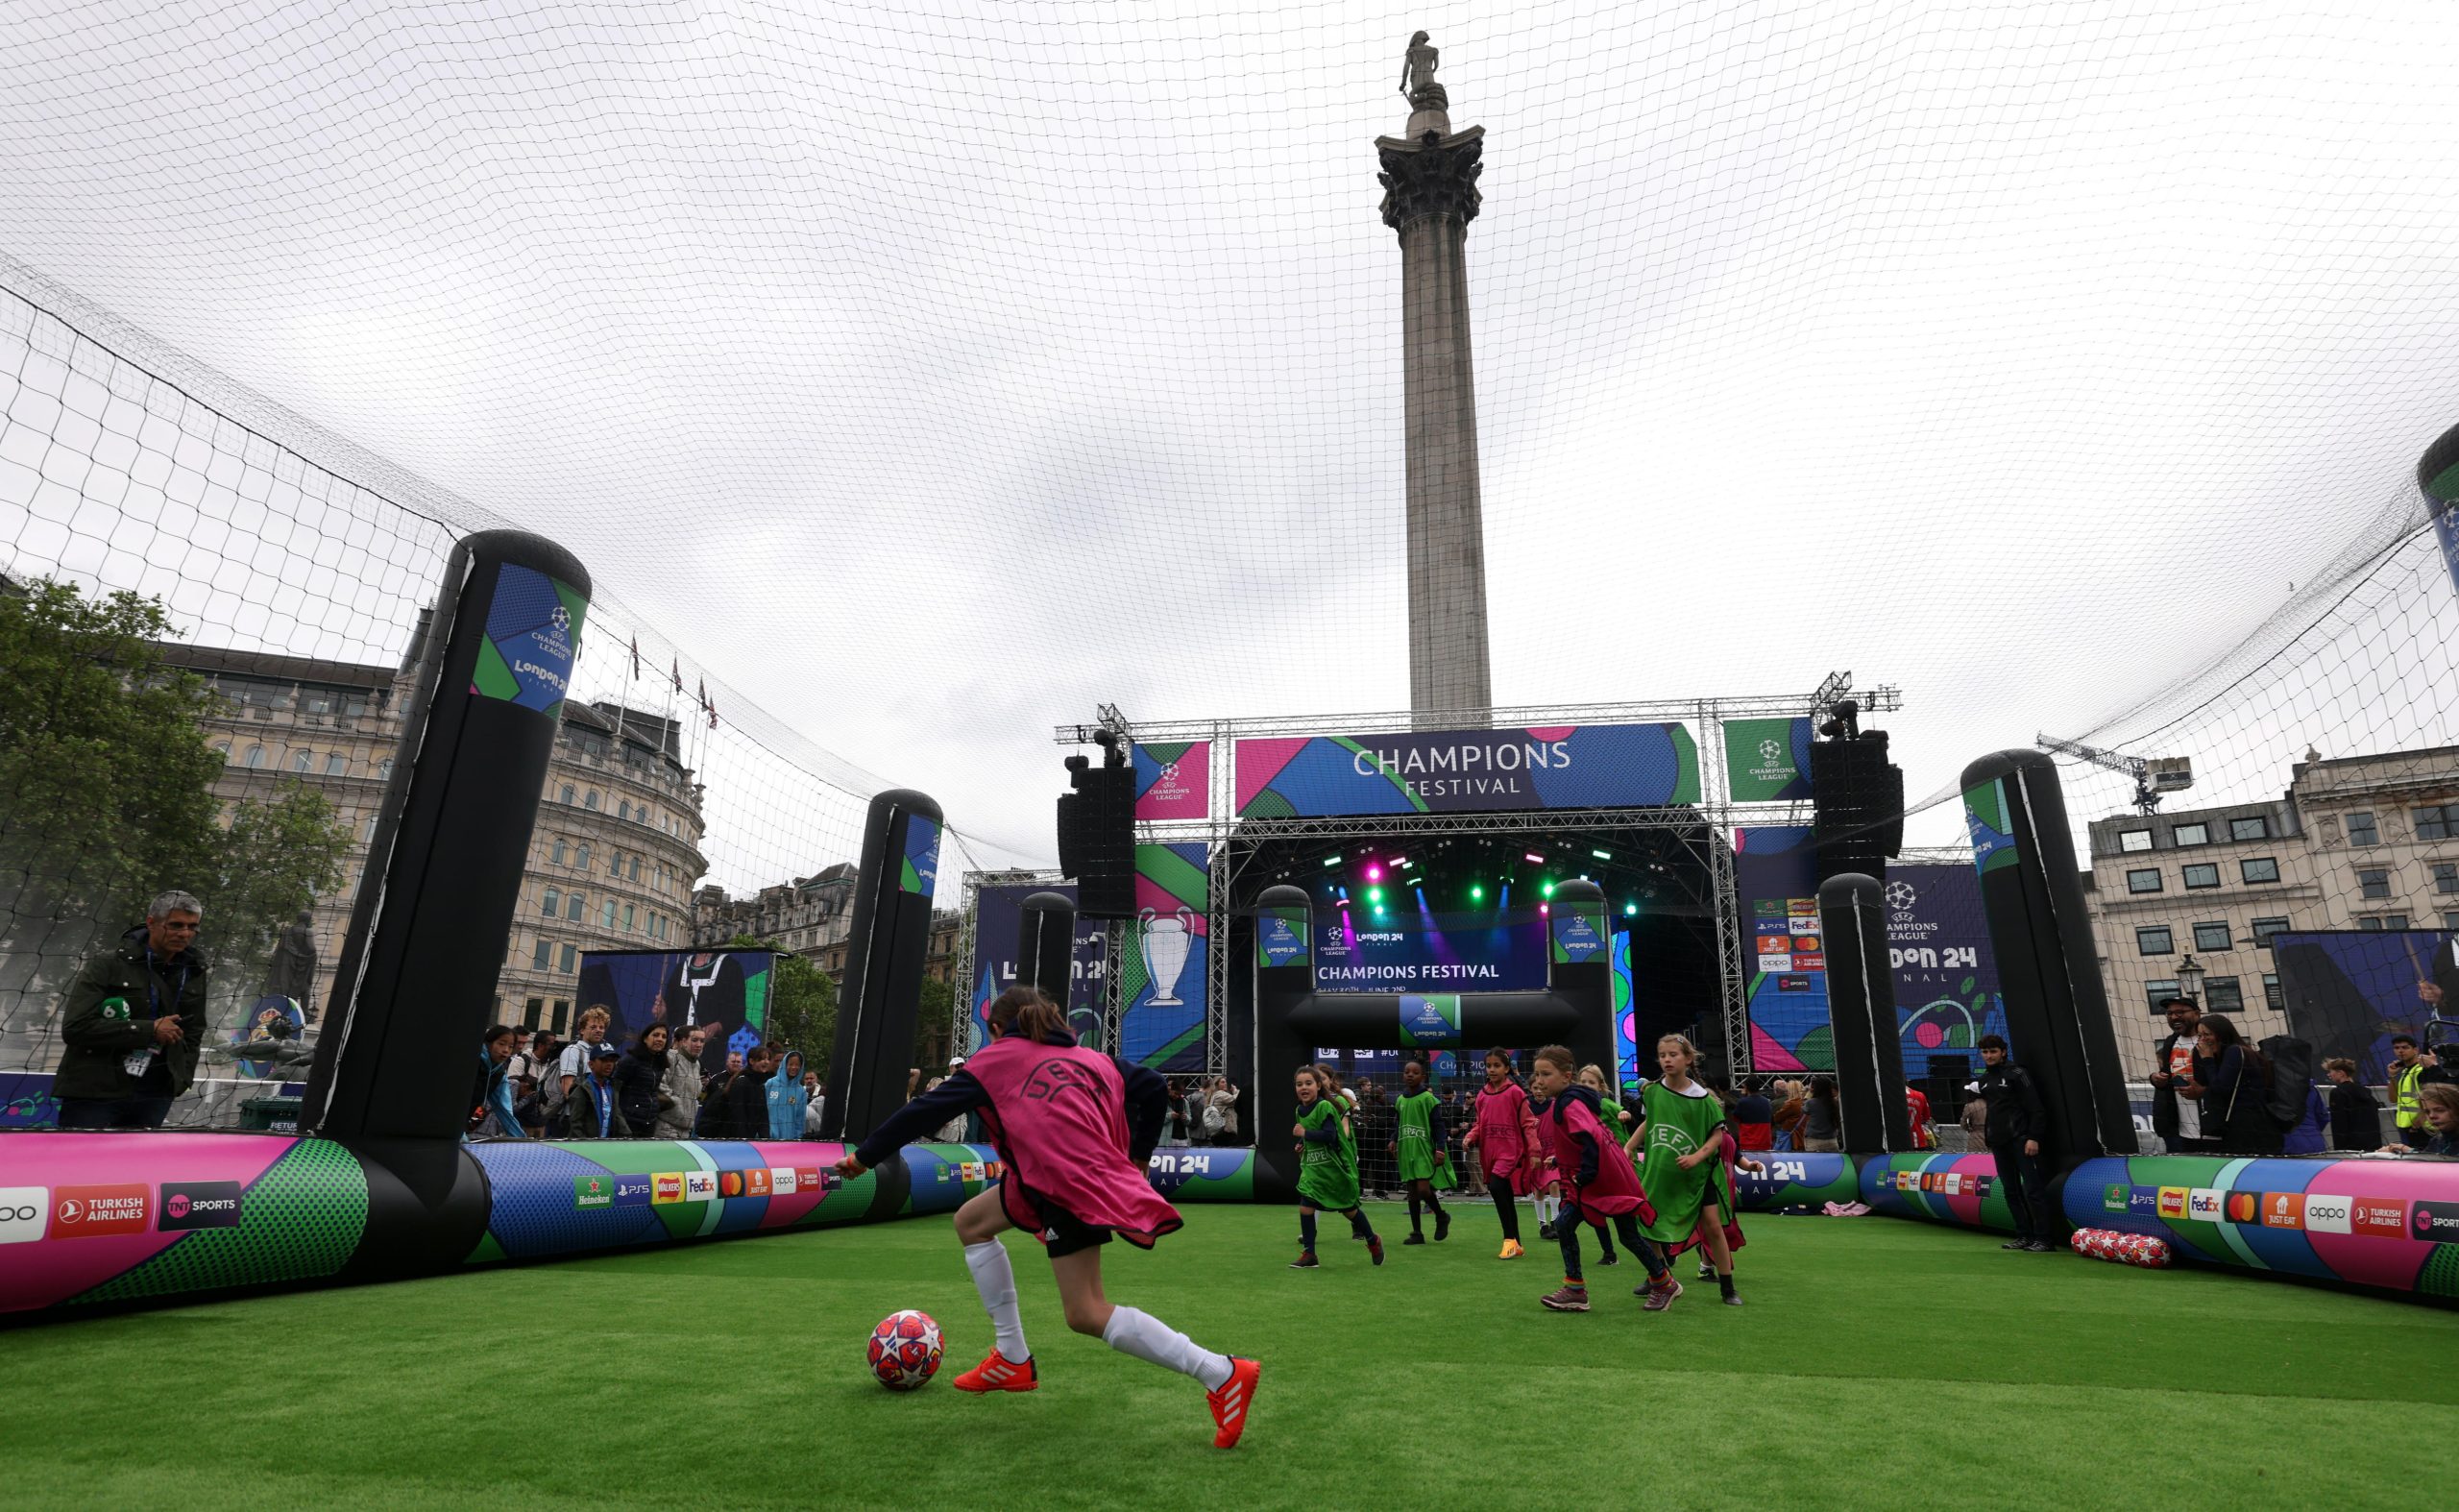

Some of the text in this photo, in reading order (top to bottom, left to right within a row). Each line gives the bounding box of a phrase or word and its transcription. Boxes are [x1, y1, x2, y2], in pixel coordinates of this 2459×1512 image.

[531, 632, 572, 657] CHAMPIONS
[539, 643, 567, 661] LEAGUE
[1353, 742, 1571, 776] CHAMPIONS
[1405, 778, 1521, 796] FESTIVAL
[1891, 912, 1915, 922] UEFA
[1792, 921, 1819, 930] FedEx
[1887, 932, 1928, 940] EAGUE
[1889, 947, 1978, 968] Don 24
[1318, 964, 1499, 979] CHAMPIONS FESTIVAL
[1904, 973, 1947, 982] NAL
[769, 1090, 779, 1100] 99
[1181, 1156, 1209, 1173] 24
[1771, 1161, 1806, 1181] 24
[690, 1178, 715, 1192] FedEx
[775, 1176, 793, 1186] oppo
[628, 1184, 649, 1194] PS5
[658, 1182, 680, 1193] WALKERS
[88, 1198, 143, 1209] TURKISH
[578, 1194, 610, 1206] Heineken
[2138, 1196, 2155, 1205] PS5
[2163, 1196, 2183, 1207] WALKERS
[2191, 1196, 2219, 1212] FedEx
[167, 1200, 235, 1212] TNT SPORTS
[86, 1208, 143, 1221] AIRLINES
[2309, 1207, 2346, 1220] oppo
[2370, 1207, 2401, 1218] TURKISH
[2269, 1214, 2296, 1225] JUST EAT
[2369, 1217, 2401, 1227] AIRLINES
[2417, 1216, 2431, 1226] TNT
